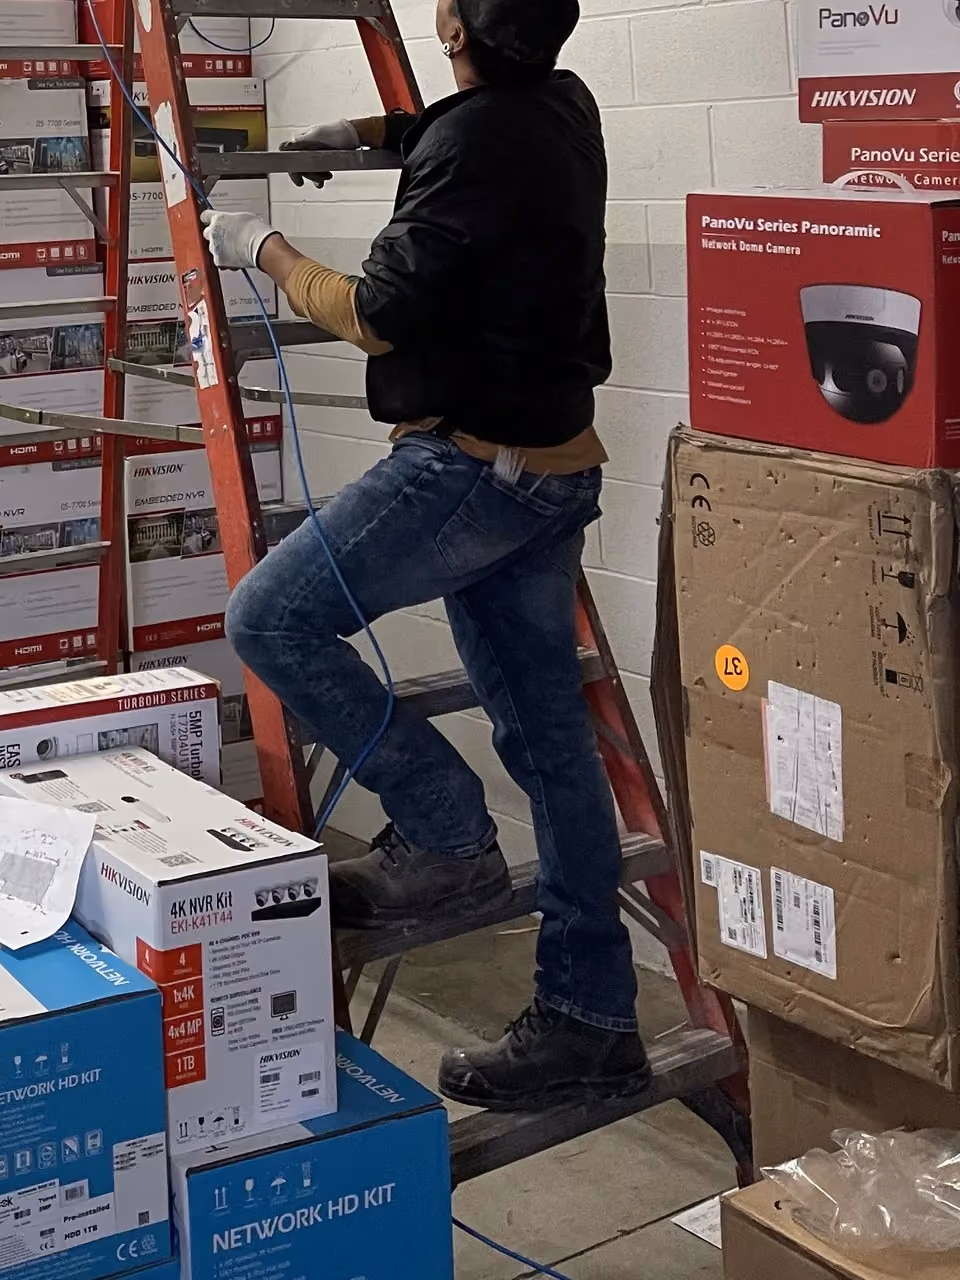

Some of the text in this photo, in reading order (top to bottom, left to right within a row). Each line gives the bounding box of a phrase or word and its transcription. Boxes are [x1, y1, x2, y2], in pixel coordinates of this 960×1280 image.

[819, 4, 899, 29] PanoVu
[810, 88, 917, 108] HIKVISION
[850, 147, 915, 162] PanoVu
[702, 216, 881, 238] PanoVu Series Panoramic
[702, 239, 800, 255] Network Dome Camera
[10, 445, 37, 455] HDMI
[133, 463, 183, 478] HIKVISION
[135, 490, 205, 507] EMBEDDED NVR
[3, 508, 25, 518] NVR
[15, 644, 42, 655] HDMI
[724, 656, 743, 676] 37
[118, 687, 206, 711] TURBOHD SERIES
[189, 710, 203, 738] 5MP
[101, 862, 151, 907] HIKVISION
[170, 891, 232, 919] 4K NVR Kit
[171, 910, 233, 934] EKI-K41T44
[69, 939, 129, 987] NETWORK
[173, 985, 194, 1003] 1x4K
[168, 1023, 186, 1039] 4x4
[260, 1048, 302, 1064] HIKVISION
[58, 1074, 79, 1091] HD
[81, 1068, 102, 1084] KIT
[63, 1203, 111, 1223] Pre-installed
[212, 1183, 397, 1255] NETWORK HD KIT
[64, 1230, 81, 1241] HDD
[116, 1239, 139, 1261] CE
